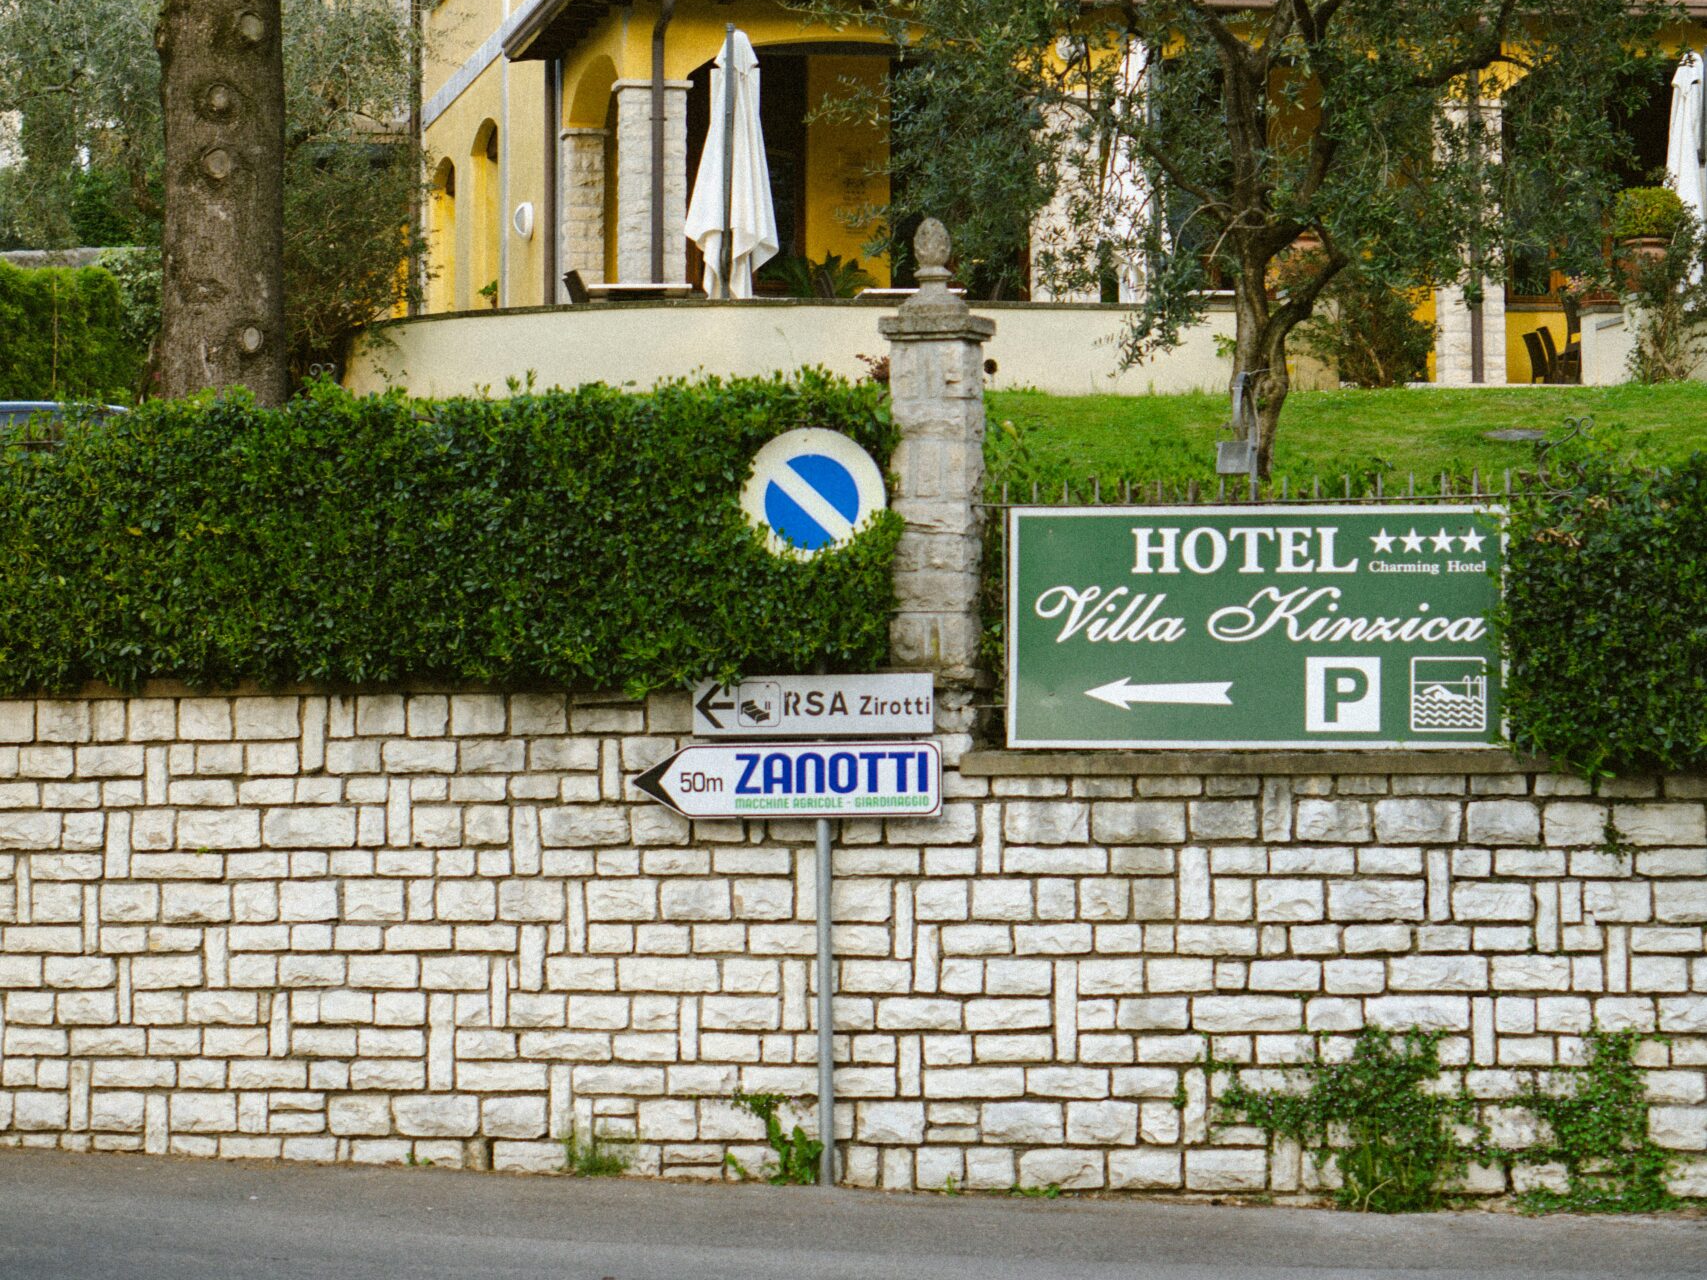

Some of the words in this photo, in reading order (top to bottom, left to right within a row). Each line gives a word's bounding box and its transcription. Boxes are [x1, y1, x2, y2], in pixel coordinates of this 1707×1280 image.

[1130, 527, 1358, 574] HOTEL
[1368, 560, 1440, 574] Charming
[1447, 560, 1487, 573] Hotel
[1034, 585, 1187, 643] Villa
[1207, 586, 1488, 643] Kinzica
[783, 690, 848, 717] RSA
[859, 695, 930, 716] Zirotti
[1324, 667, 1369, 723] P
[680, 772, 723, 793] 50m
[735, 751, 929, 795] ZANOTTI
[735, 797, 790, 809] MACCHINE
[793, 796, 844, 809] AGRICOLE
[854, 795, 930, 808] GIARDINAGGIO
